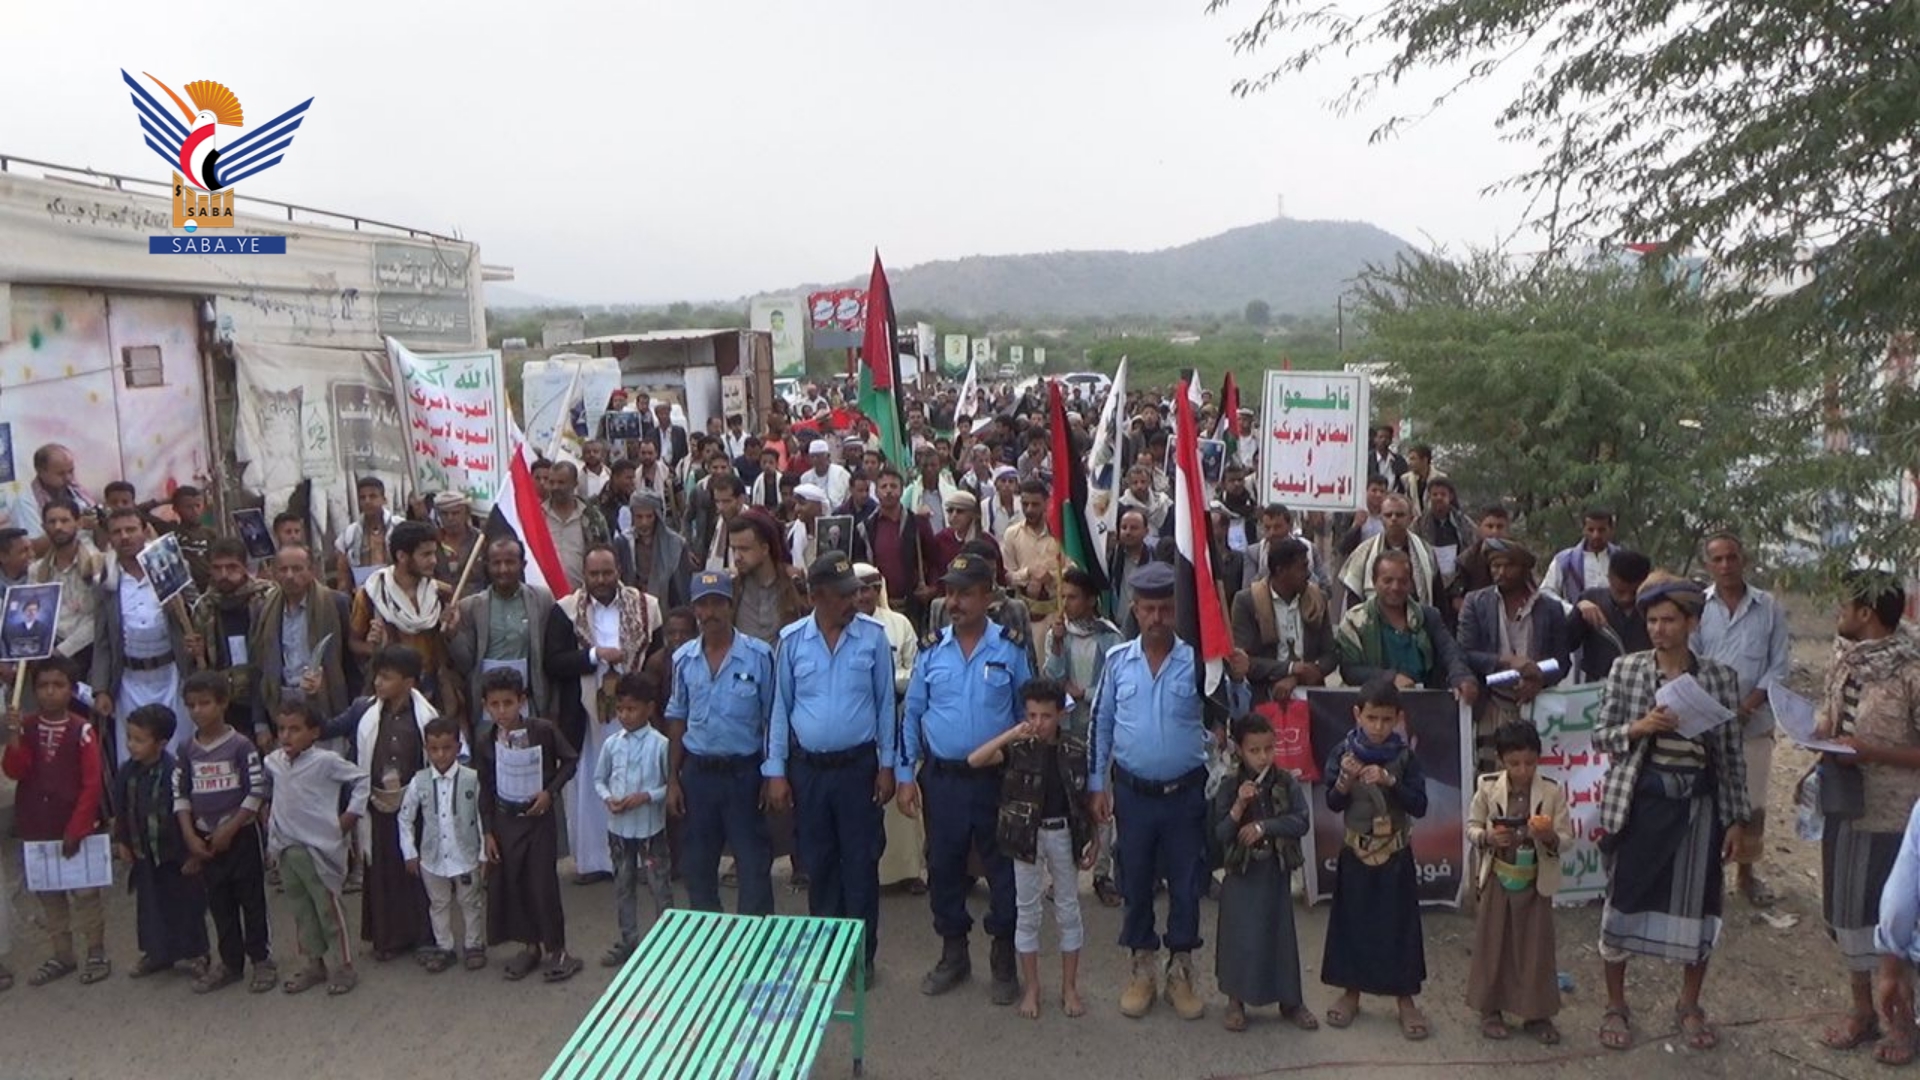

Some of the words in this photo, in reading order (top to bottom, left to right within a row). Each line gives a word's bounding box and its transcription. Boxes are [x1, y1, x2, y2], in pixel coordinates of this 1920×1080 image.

[454, 364, 490, 388] الله
[455, 399, 493, 417] الموت
[1279, 383, 1350, 415] قاطعوا
[455, 425, 494, 445] الموت
[1316, 421, 1354, 447] البضائع
